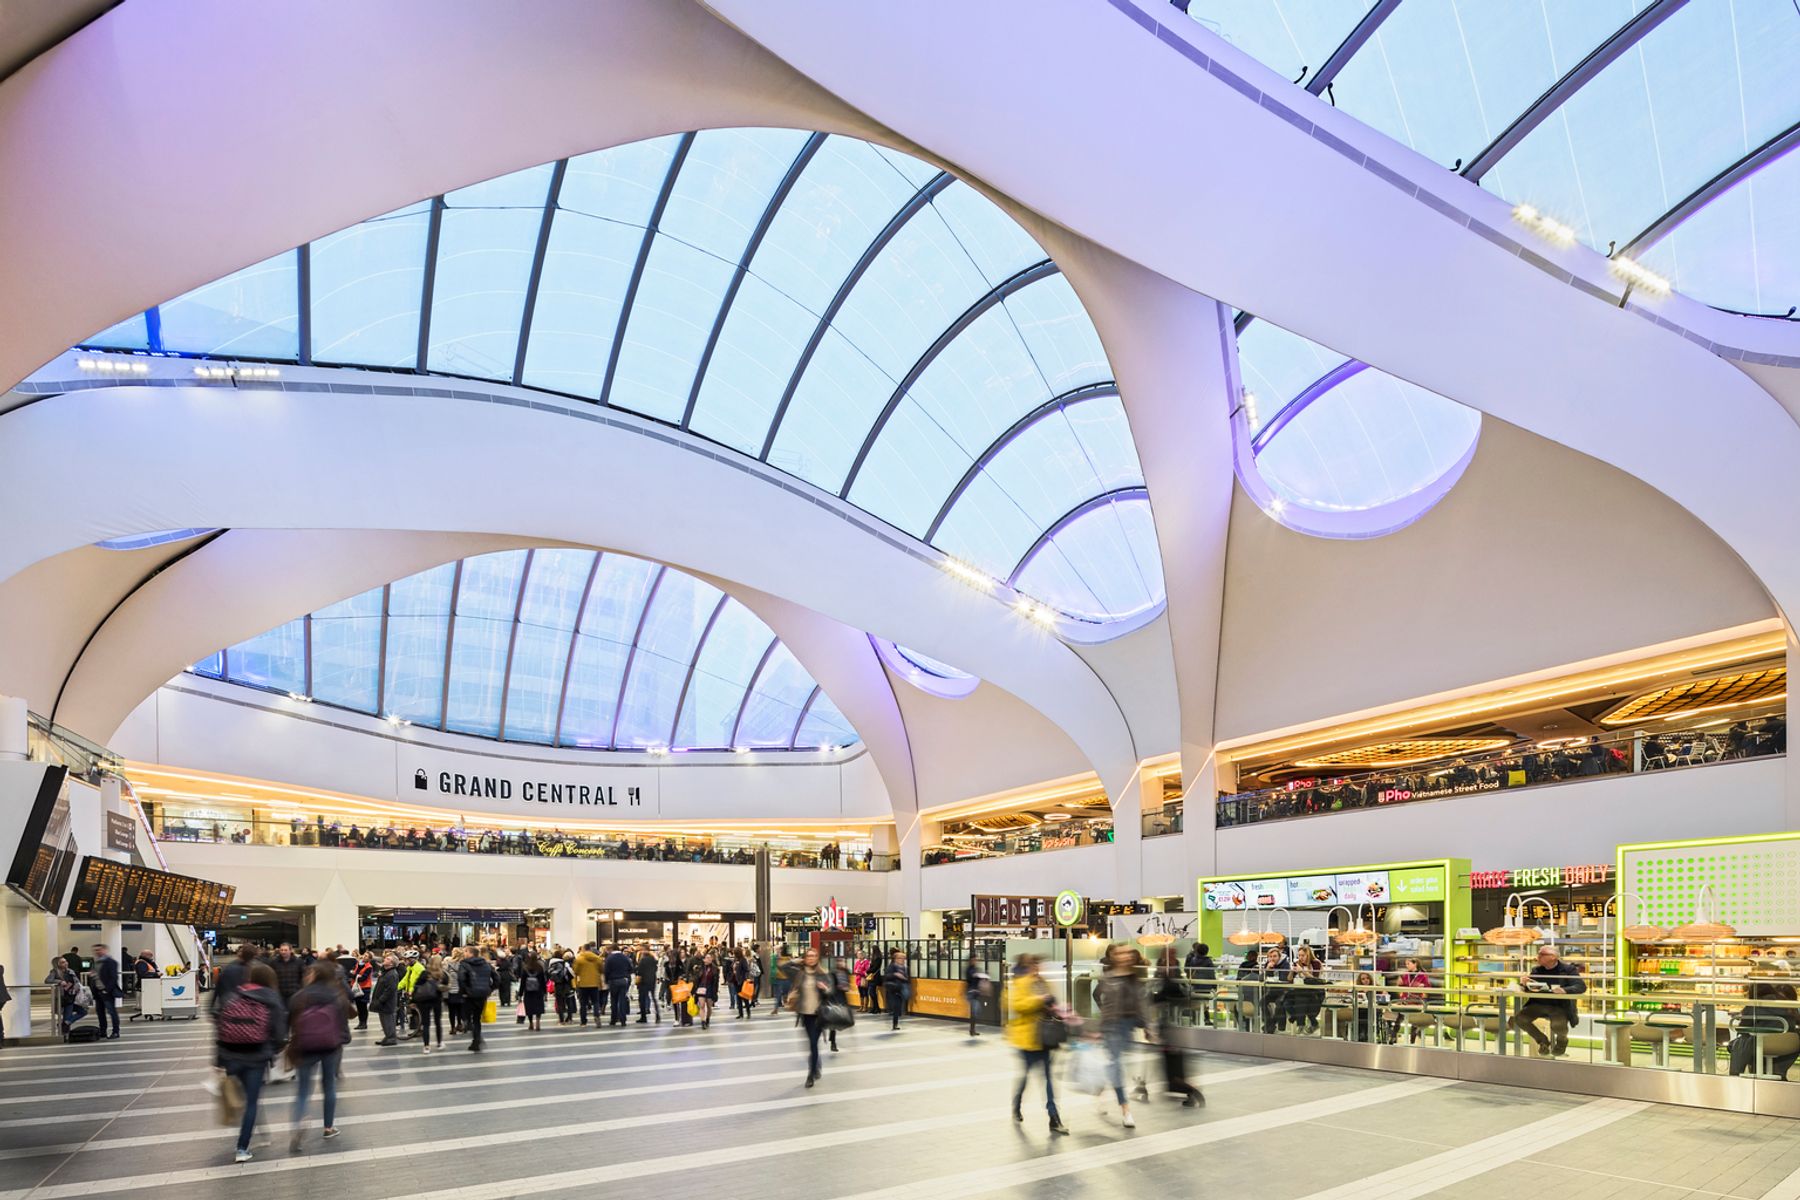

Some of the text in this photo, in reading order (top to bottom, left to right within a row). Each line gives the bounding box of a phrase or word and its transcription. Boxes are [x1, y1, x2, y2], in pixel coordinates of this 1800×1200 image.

[439, 771, 617, 806] GRAND CENTRAL
[1386, 780, 1499, 802] Pho Vietnamese Street Food
[563, 840, 606, 855] Concerto
[1470, 864, 1608, 888] MADE FRESH DAILY
[821, 906, 848, 927] PRET
[869, 920, 874, 928] 5
